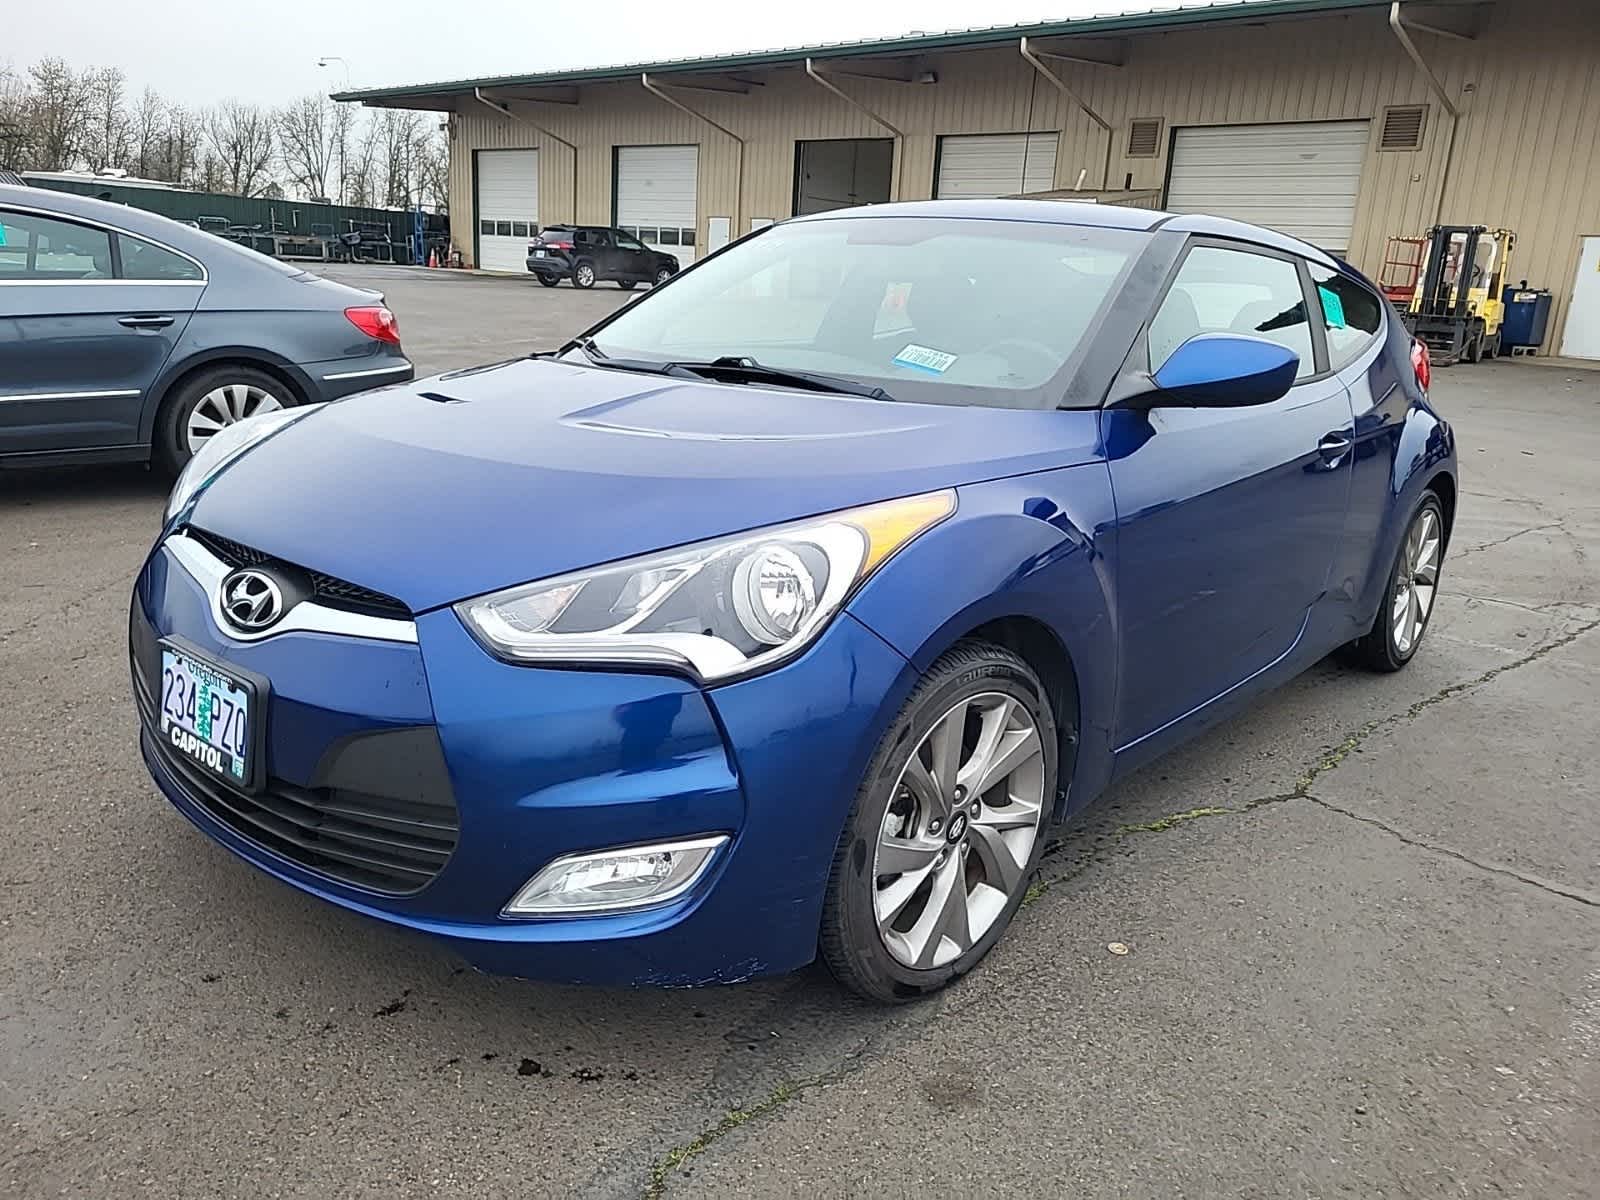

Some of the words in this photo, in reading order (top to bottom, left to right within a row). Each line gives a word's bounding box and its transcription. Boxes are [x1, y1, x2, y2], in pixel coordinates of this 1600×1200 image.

[164, 668, 196, 730] 234
[210, 692, 246, 758] PZQ
[171, 727, 224, 773] CAPITOL
